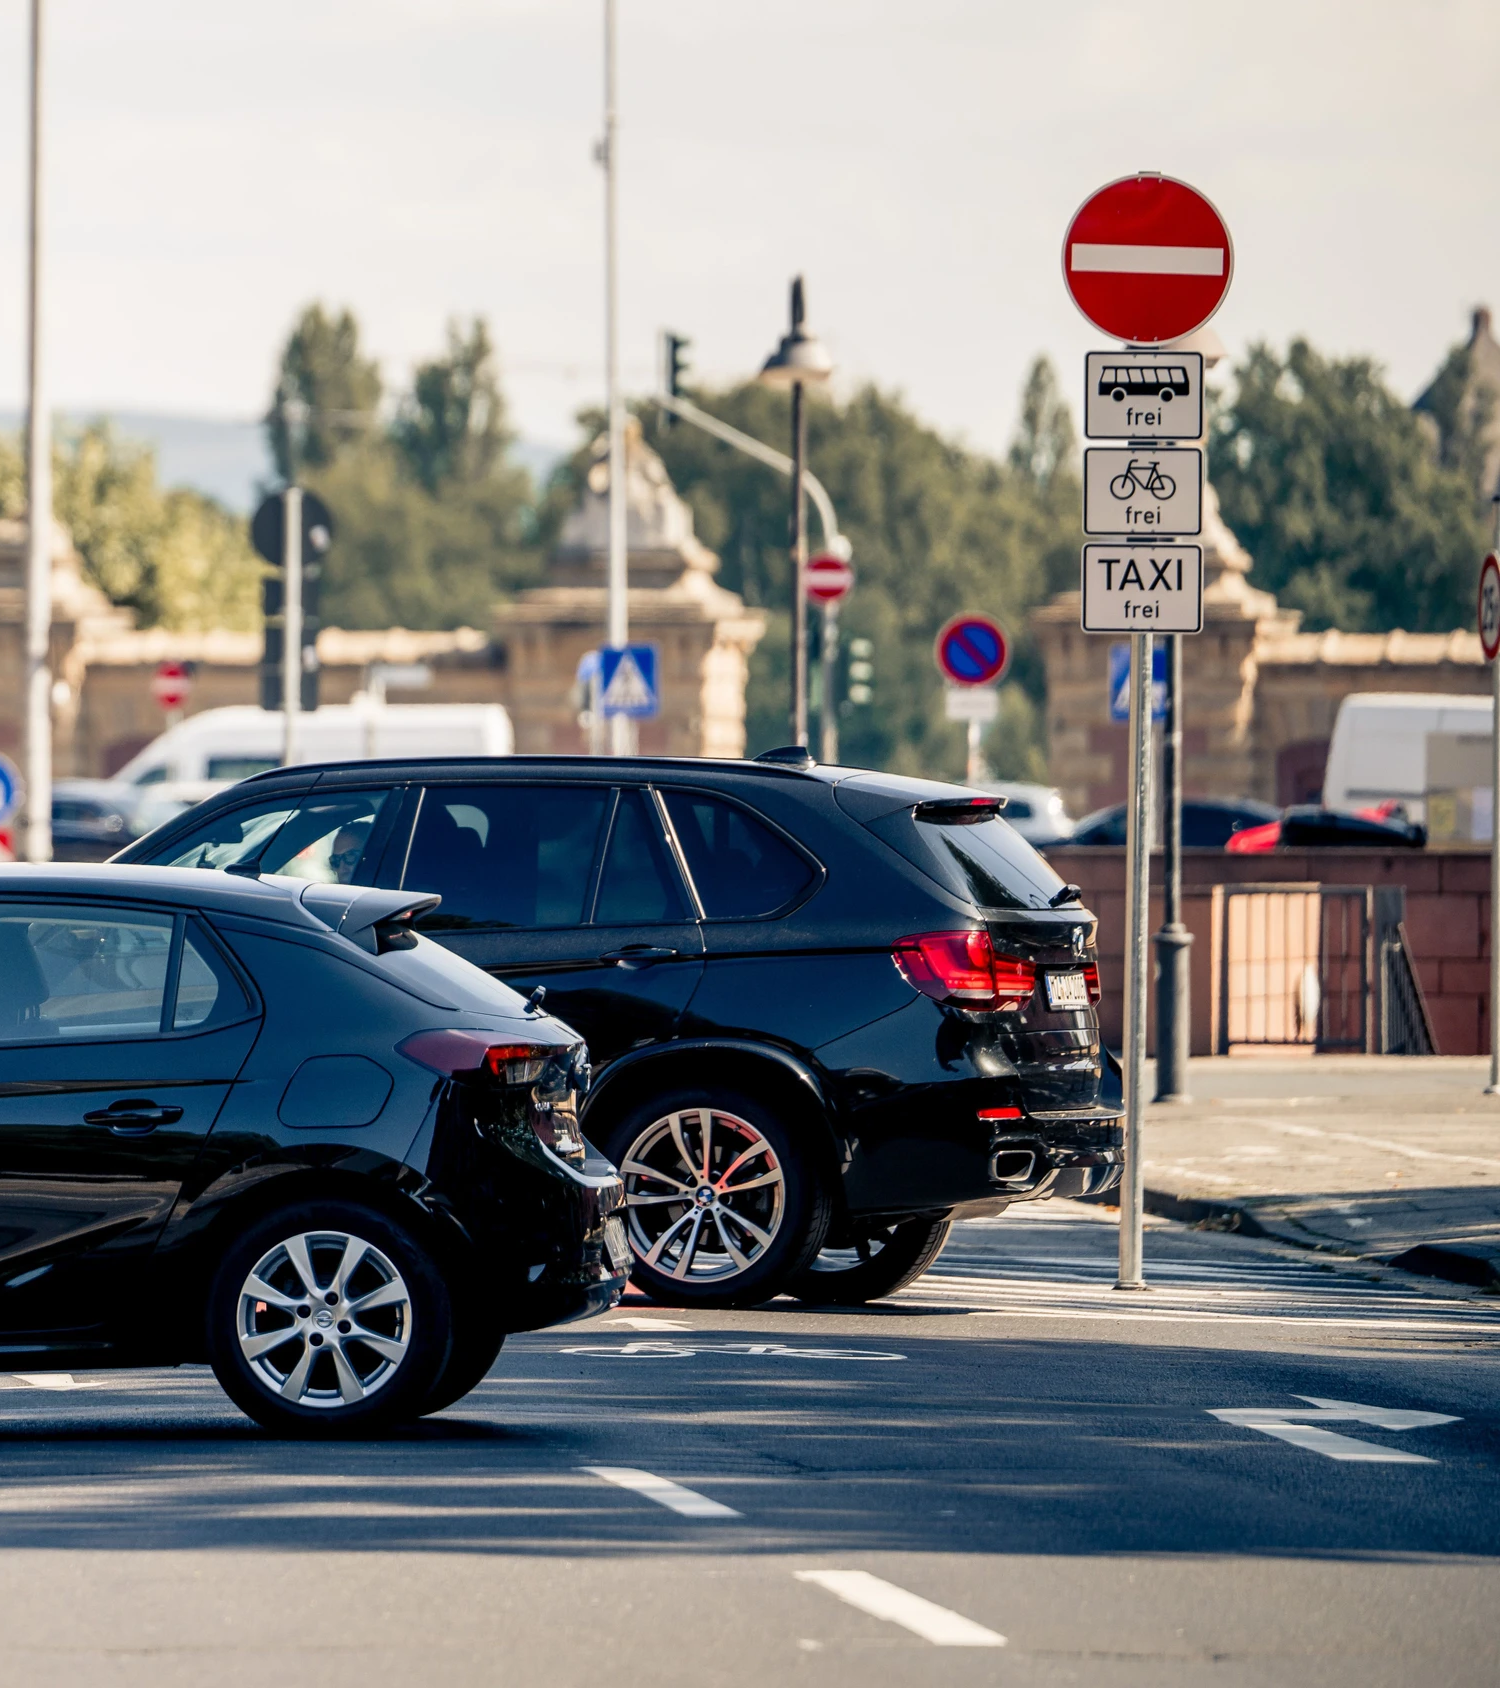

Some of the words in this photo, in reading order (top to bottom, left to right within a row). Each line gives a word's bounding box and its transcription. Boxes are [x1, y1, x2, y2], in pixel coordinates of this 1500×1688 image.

[1126, 407, 1162, 426] frei
[1125, 506, 1161, 524] frei
[1097, 558, 1183, 591] TAXI
[1124, 600, 1160, 619] frei
